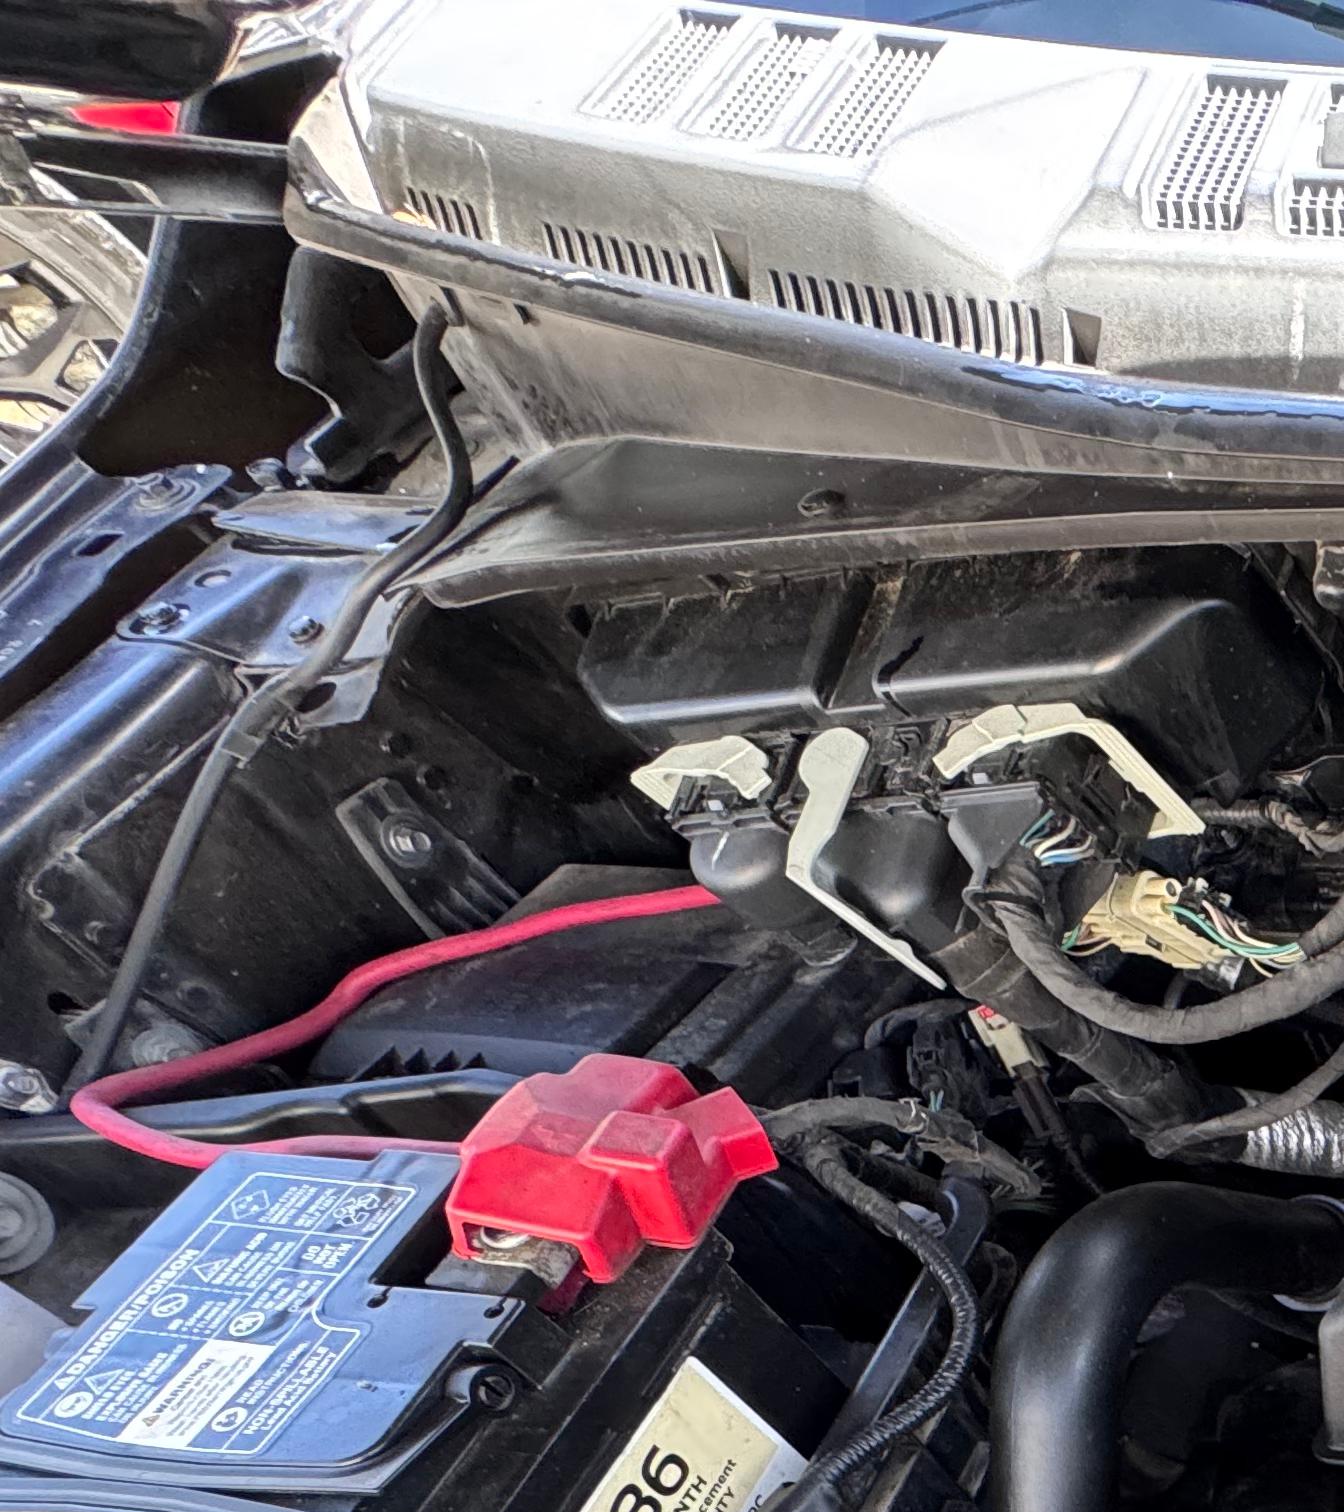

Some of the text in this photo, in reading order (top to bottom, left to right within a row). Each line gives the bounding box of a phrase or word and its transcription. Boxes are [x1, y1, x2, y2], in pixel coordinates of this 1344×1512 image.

[298, 1245, 323, 1260] DO
[309, 1244, 338, 1264] NOT
[319, 1242, 355, 1269] OPEN
[63, 1248, 201, 1375] DANGER/POISON
[242, 1345, 330, 1435] NON-SPILLABLE
